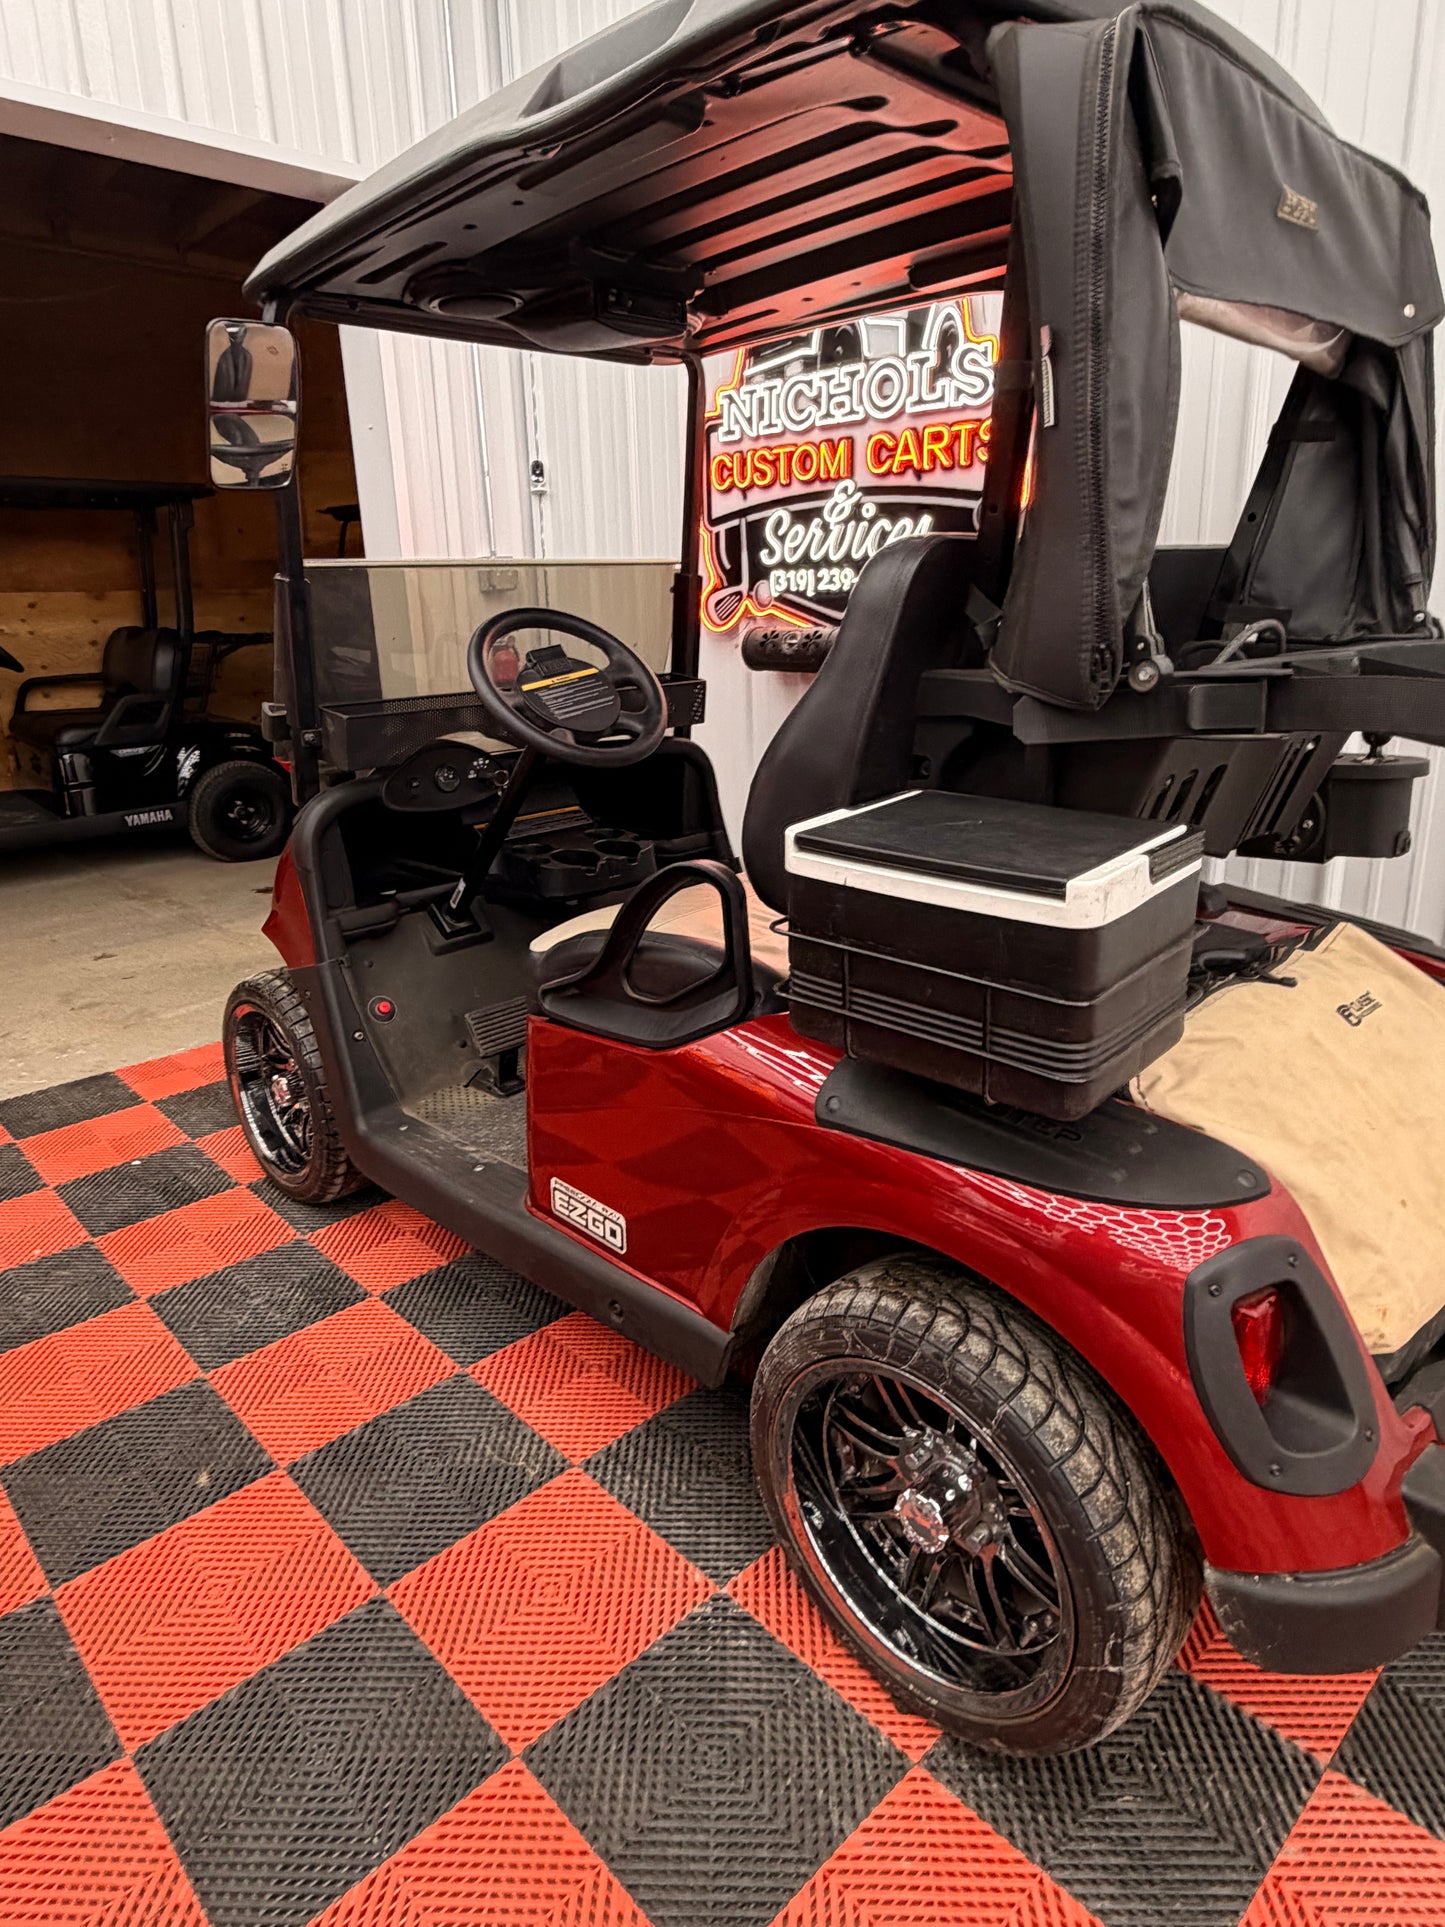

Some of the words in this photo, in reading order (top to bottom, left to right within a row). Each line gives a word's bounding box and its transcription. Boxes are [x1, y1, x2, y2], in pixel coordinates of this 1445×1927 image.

[717, 341, 995, 442] NICHOLS
[710, 435, 854, 492] CUSTOM
[822, 478, 863, 523] &
[123, 808, 174, 828] YAMAHA
